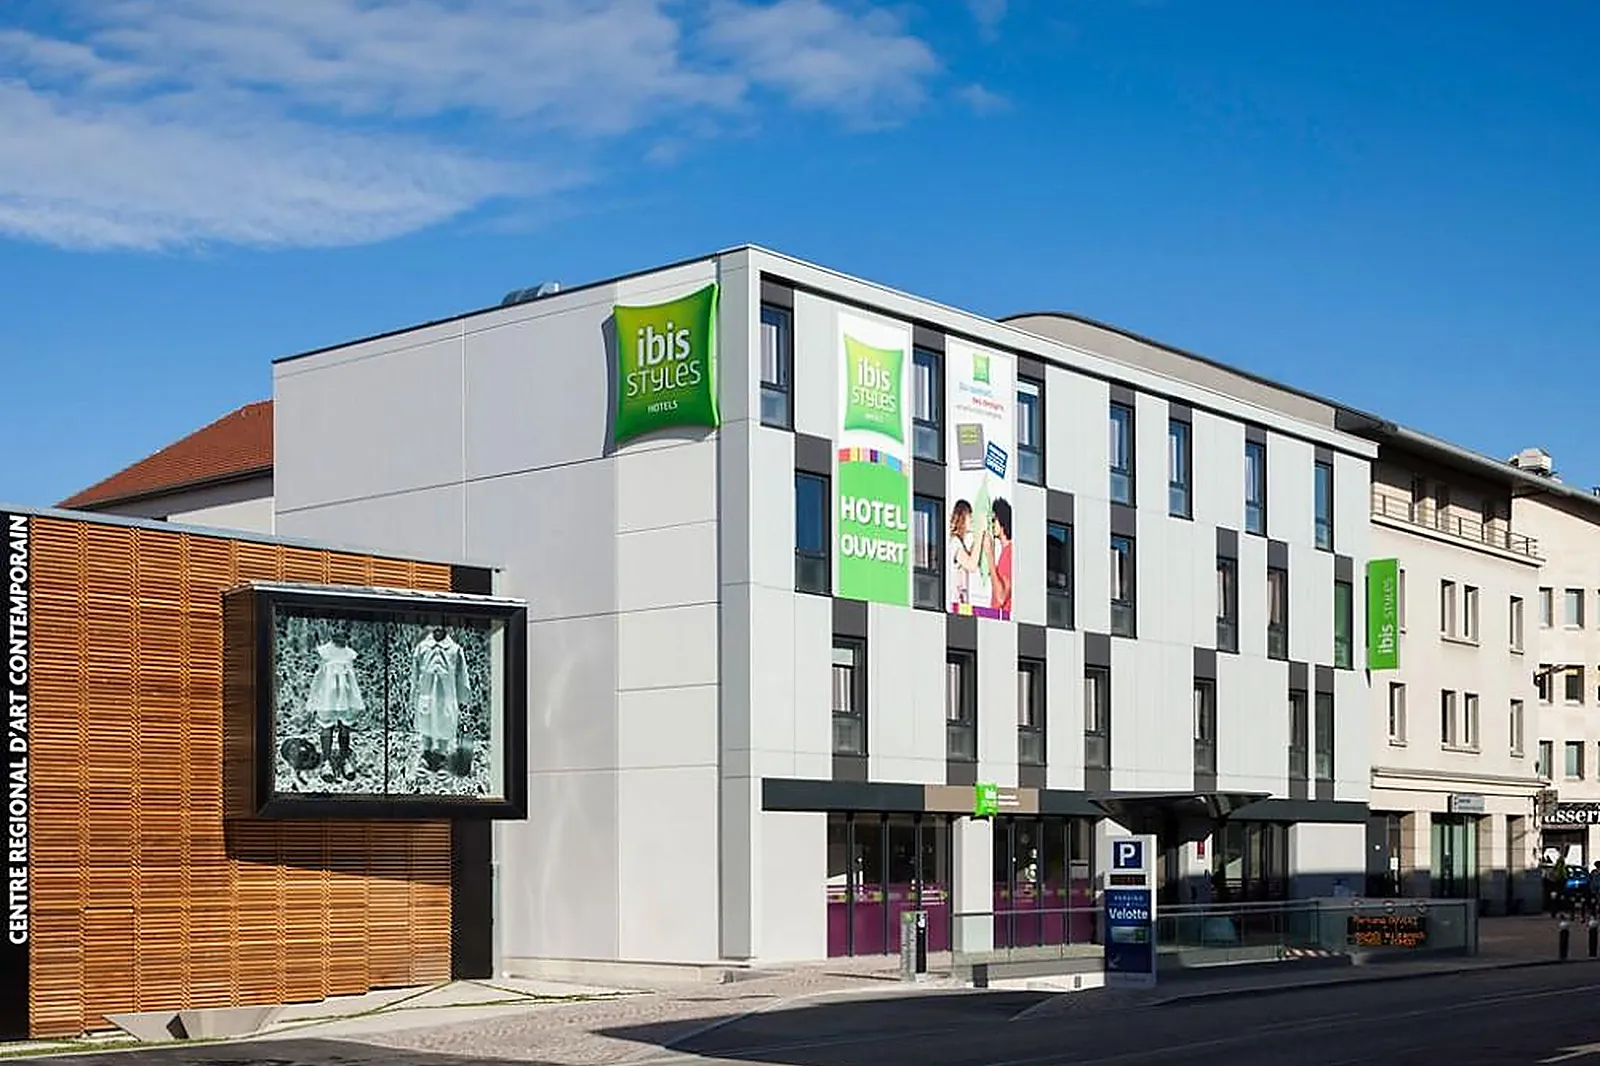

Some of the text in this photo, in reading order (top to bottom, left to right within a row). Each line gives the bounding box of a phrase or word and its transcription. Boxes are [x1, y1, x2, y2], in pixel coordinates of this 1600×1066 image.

[637, 321, 691, 368] ibis
[858, 355, 891, 392] ibis
[647, 400, 679, 413] HOTELS
[841, 494, 908, 532] HOTEL
[841, 534, 907, 564] OUVERT
[9, 514, 28, 685] CONTEMPORAIN
[1377, 623, 1394, 654] ibis
[9, 757, 28, 861] REGIONAL
[1119, 843, 1136, 867] P
[9, 866, 28, 945] CENTRE
[1108, 907, 1148, 920] Velotte
